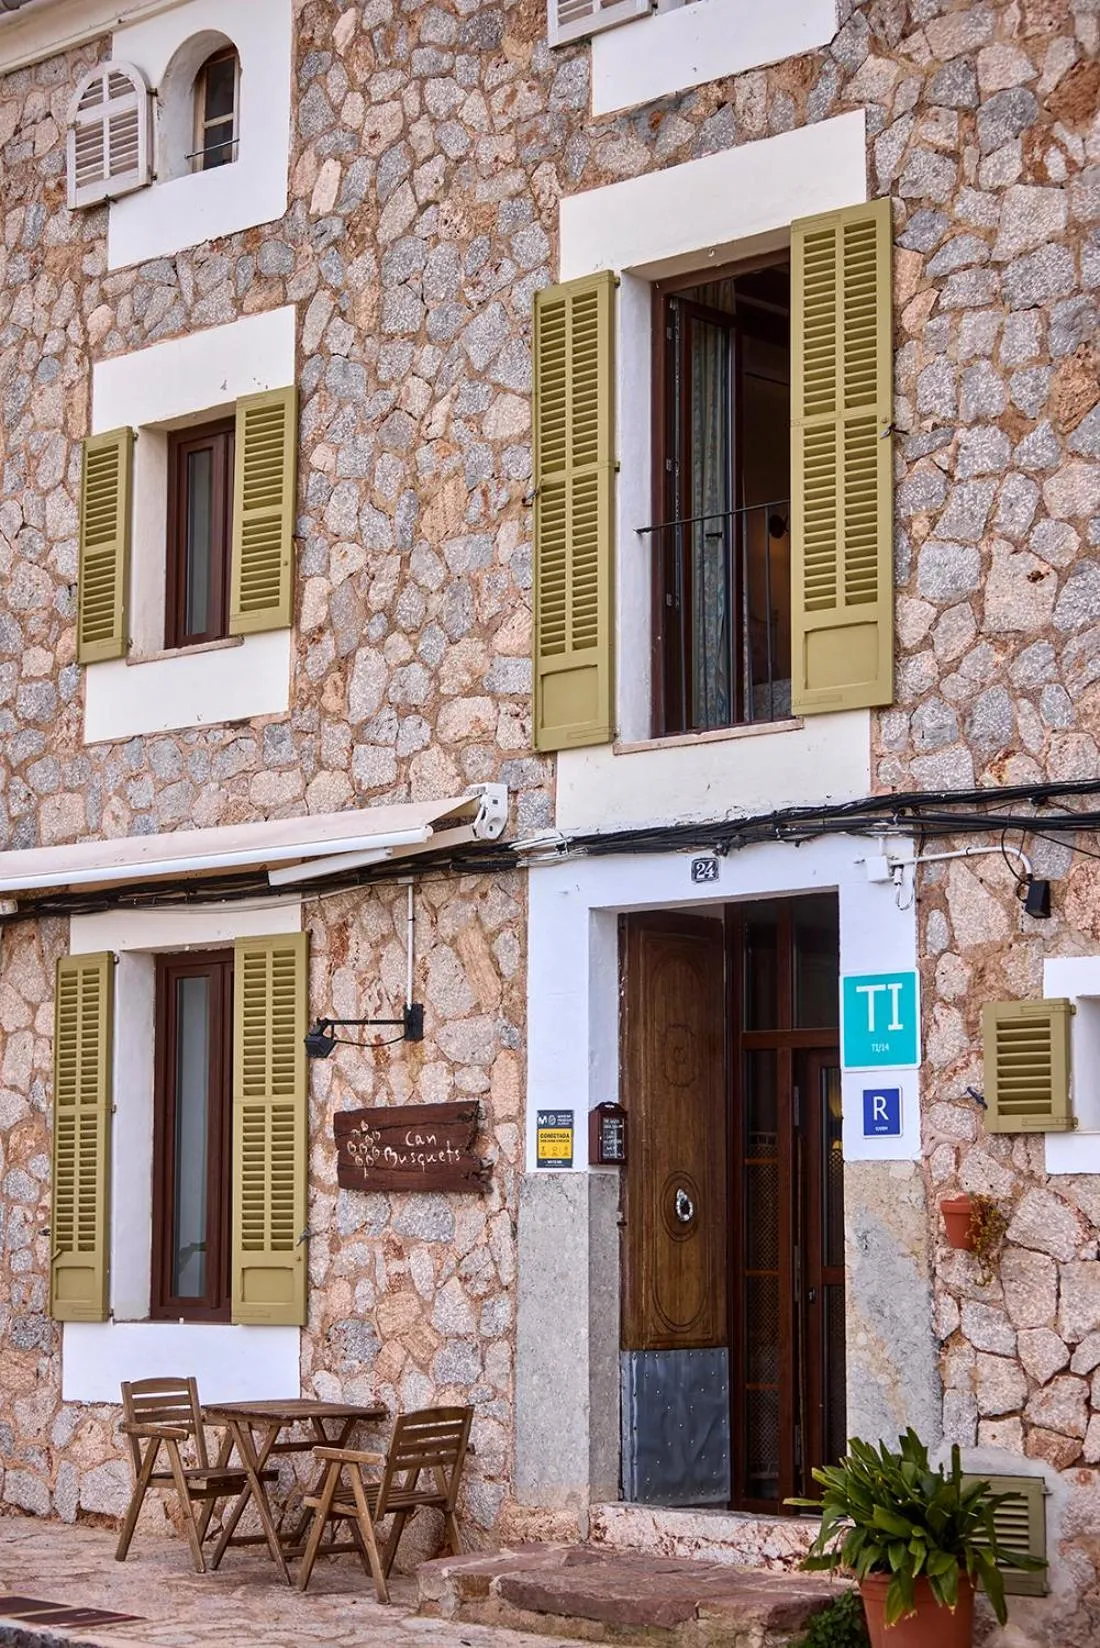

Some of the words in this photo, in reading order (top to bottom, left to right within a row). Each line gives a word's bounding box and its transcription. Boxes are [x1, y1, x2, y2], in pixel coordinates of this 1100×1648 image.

[696, 861, 714, 879] 24
[856, 983, 904, 1032] TI
[873, 1096, 889, 1121] R
[405, 1131, 437, 1146] Can
[384, 1140, 461, 1173] Busquets
